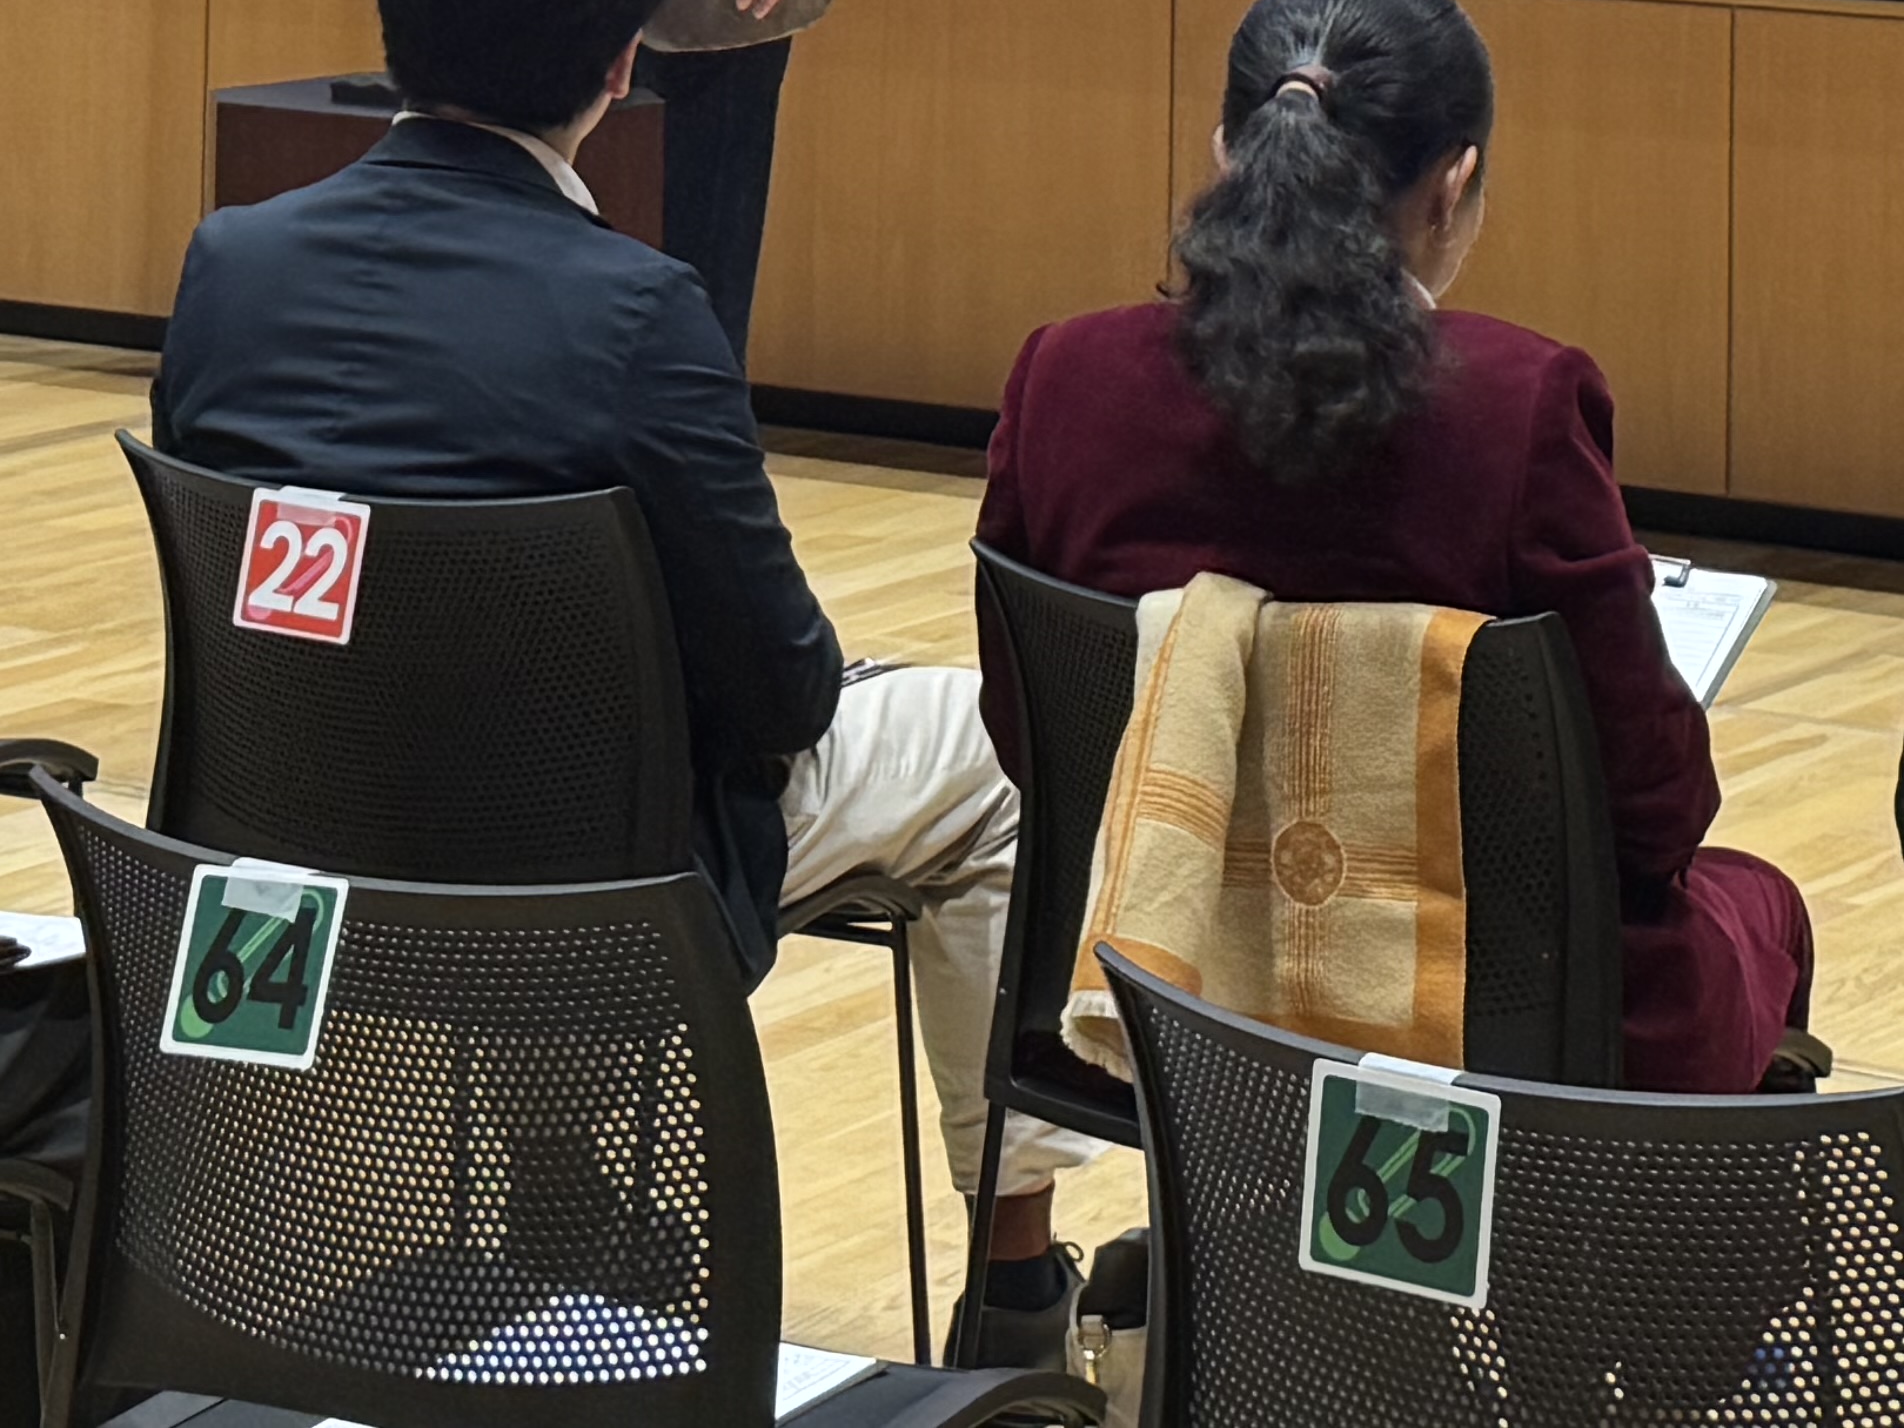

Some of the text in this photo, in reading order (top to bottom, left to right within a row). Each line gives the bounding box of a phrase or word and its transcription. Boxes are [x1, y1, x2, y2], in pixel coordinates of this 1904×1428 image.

[247, 519, 349, 622] 22
[192, 907, 317, 1030] 64
[1327, 1115, 1470, 1264] 65
